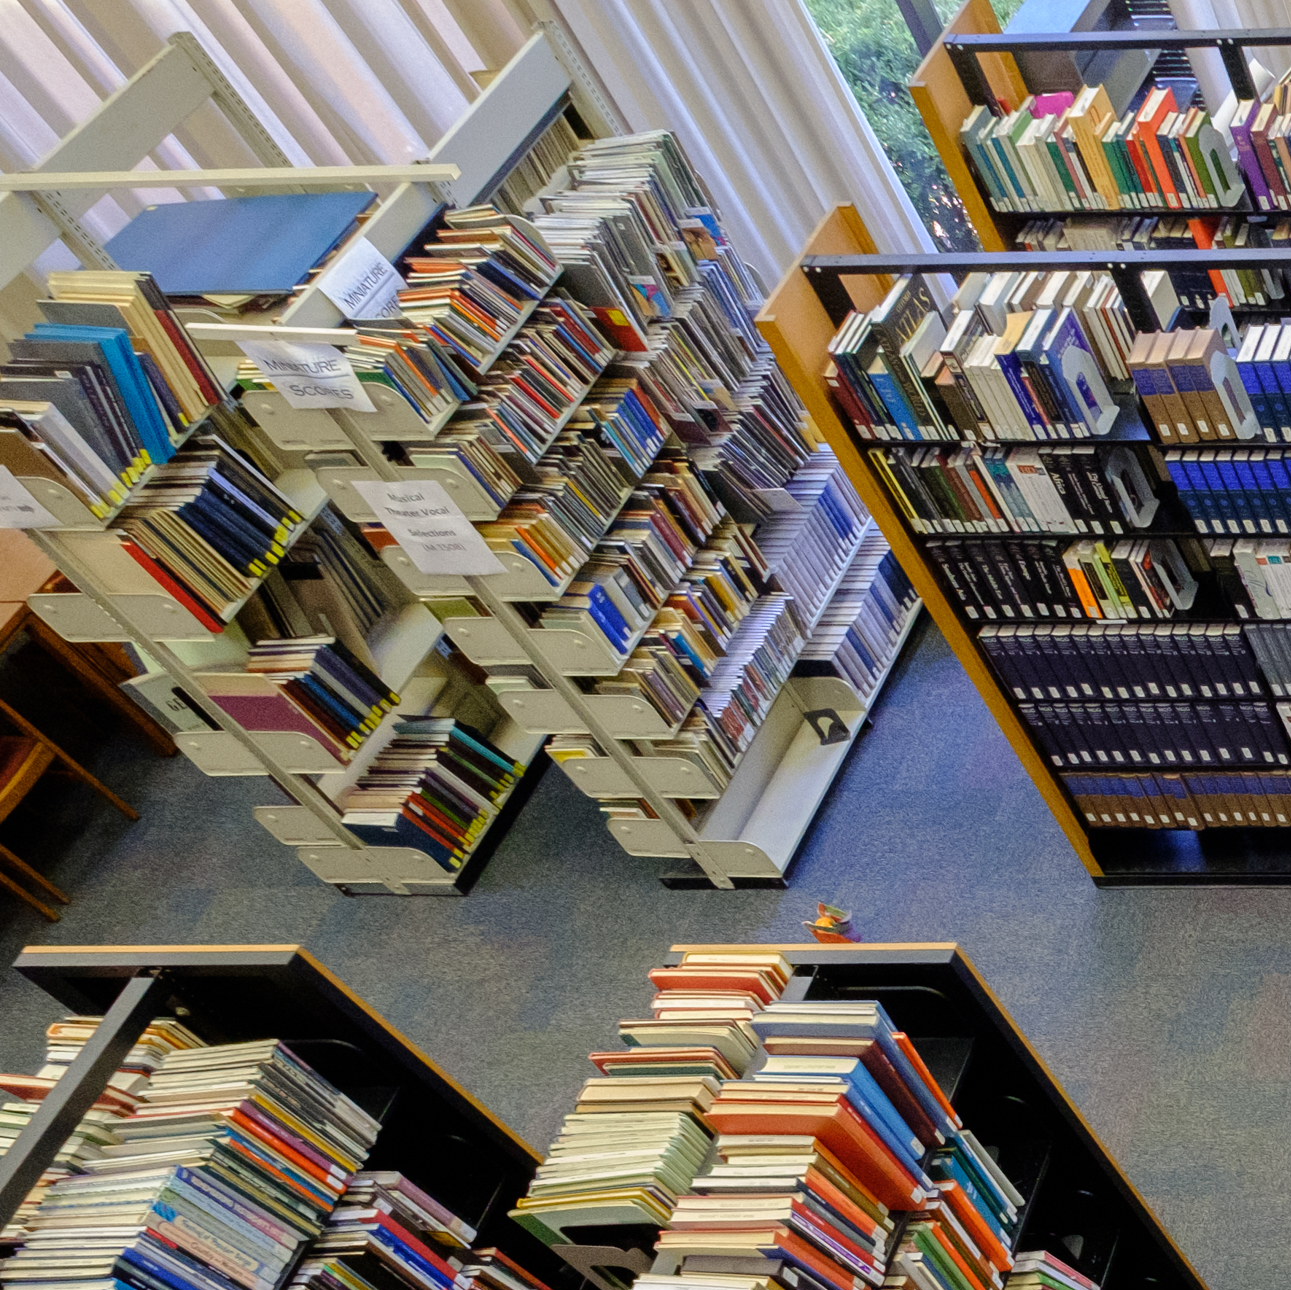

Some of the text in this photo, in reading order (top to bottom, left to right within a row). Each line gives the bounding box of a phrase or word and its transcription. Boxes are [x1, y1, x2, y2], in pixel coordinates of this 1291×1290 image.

[343, 262, 389, 310] MINIATURE
[263, 359, 342, 374] MINIATURE
[289, 384, 355, 401] SCORES
[1050, 471, 1066, 496] Africa
[387, 493, 425, 502] Musical
[385, 506, 450, 517] Theater Vocal
[408, 529, 457, 538] Selections
[188, 1240, 215, 1260] Country
